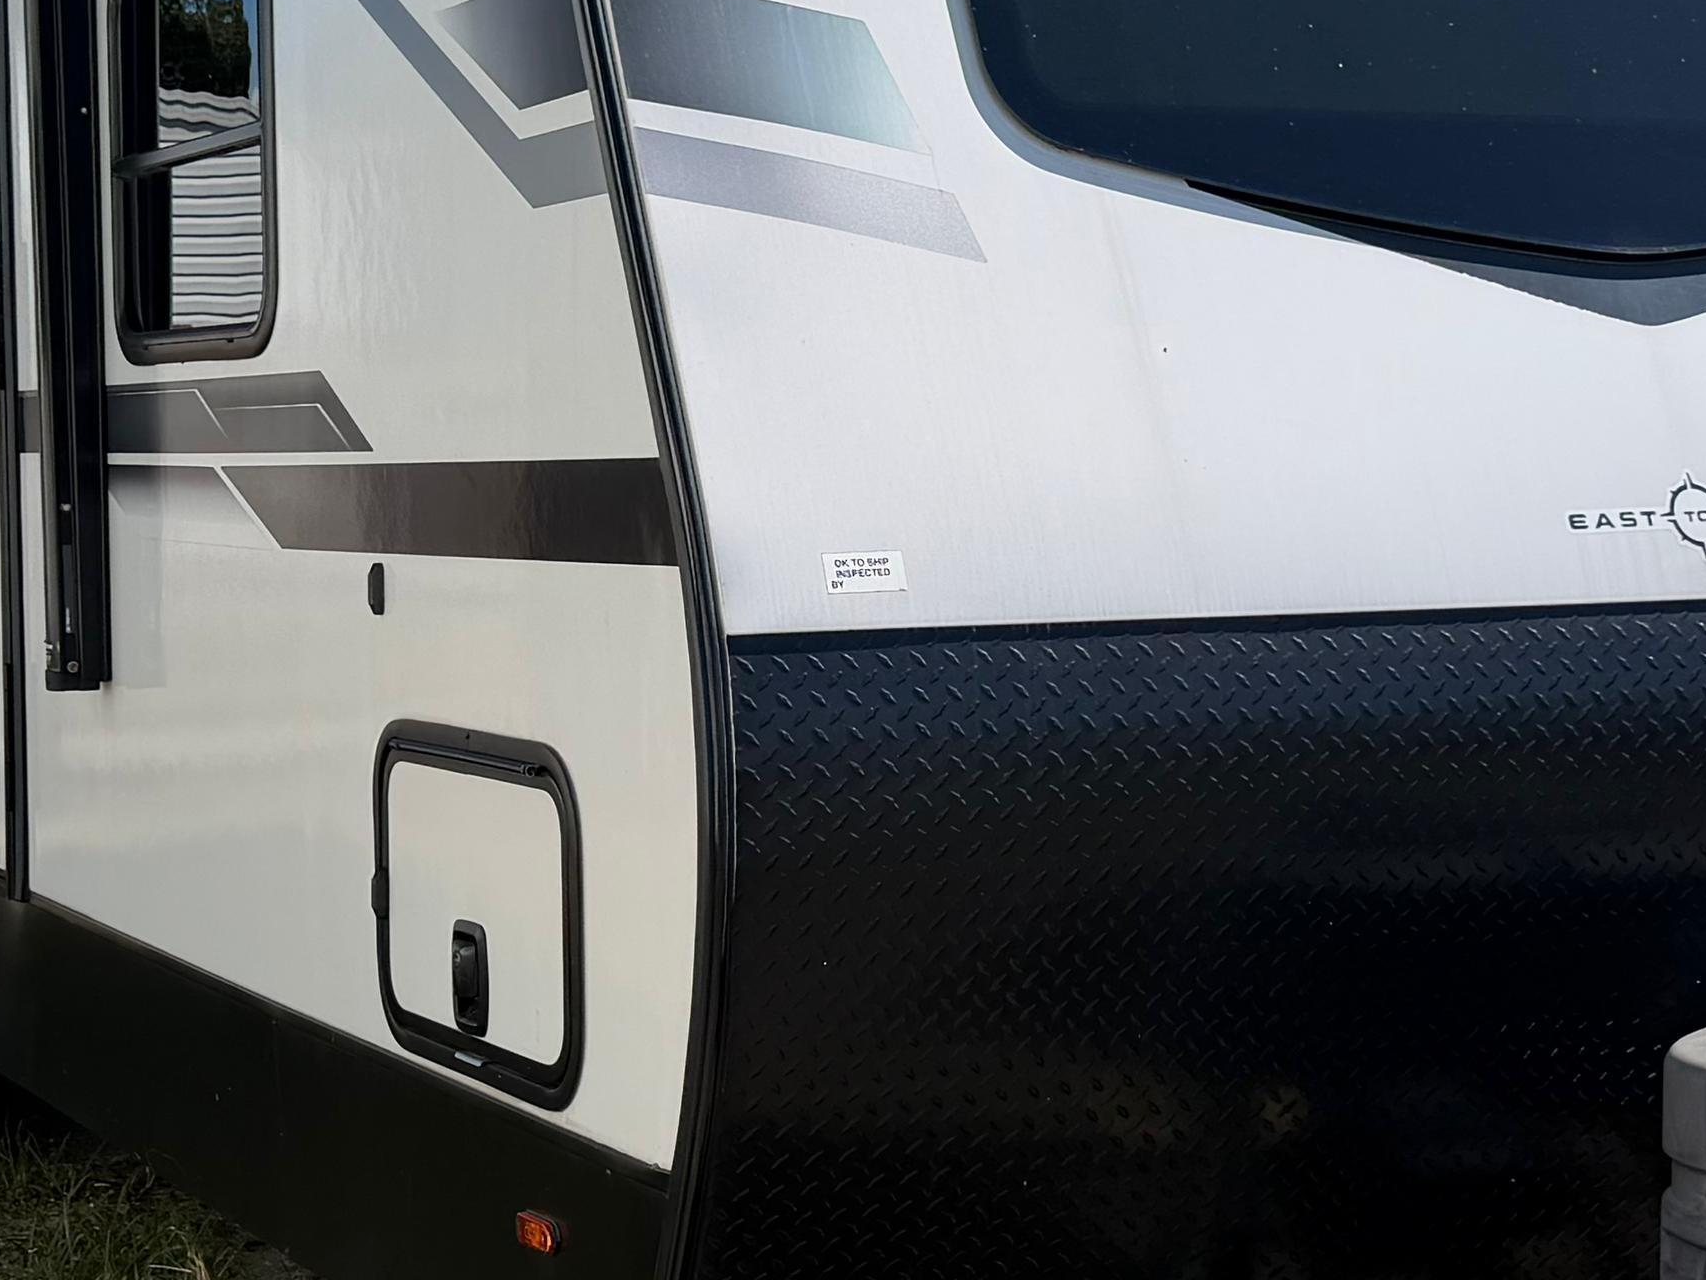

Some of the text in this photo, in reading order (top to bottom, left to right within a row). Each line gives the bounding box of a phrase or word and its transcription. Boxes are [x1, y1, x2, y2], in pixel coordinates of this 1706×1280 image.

[1568, 510, 1657, 530] EAST
[834, 559, 850, 568] OK
[851, 558, 865, 567] TO
[831, 580, 844, 589] BY
